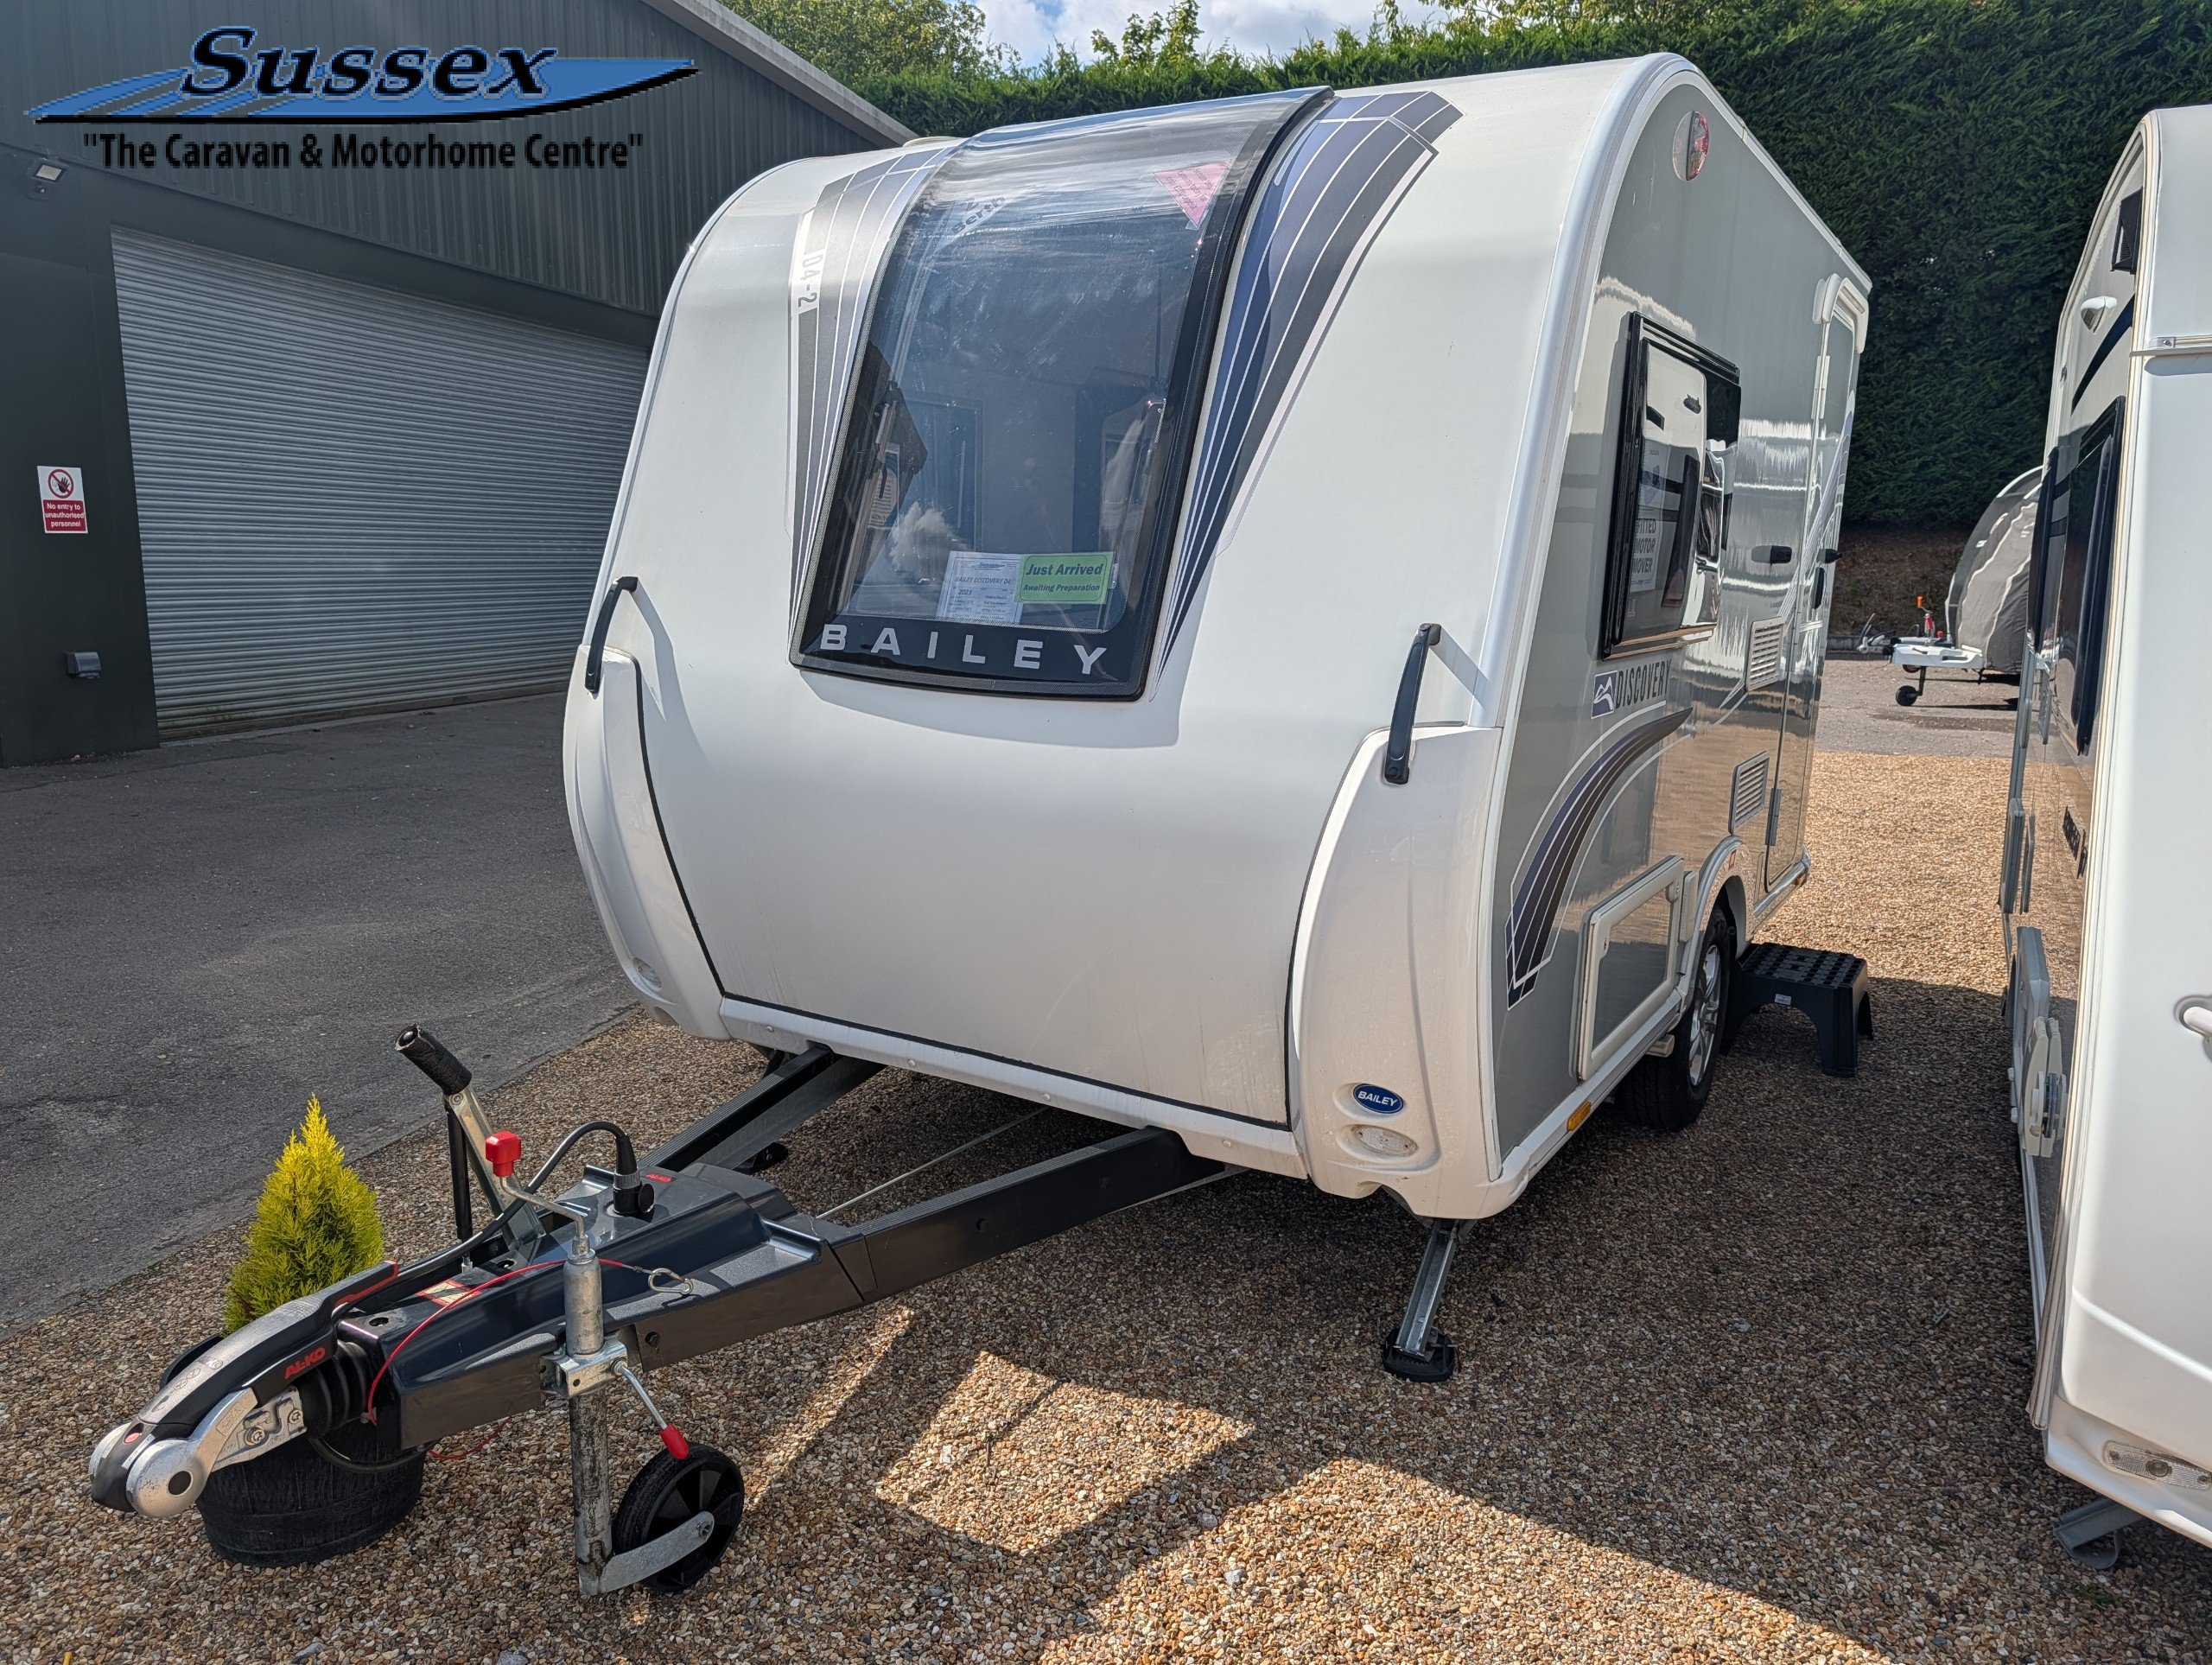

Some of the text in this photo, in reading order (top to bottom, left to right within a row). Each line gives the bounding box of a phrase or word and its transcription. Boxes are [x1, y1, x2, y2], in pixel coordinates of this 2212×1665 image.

[951, 197, 1006, 234] Berth
[1026, 563, 1054, 575] Just
[1054, 563, 1104, 575] Arrived
[1022, 584, 1100, 593] Awaiting Preparation
[820, 623, 1107, 675] BAILEY
[1615, 659, 1672, 709] DISCOVERY
[1357, 1090, 1398, 1106] BAILEY
